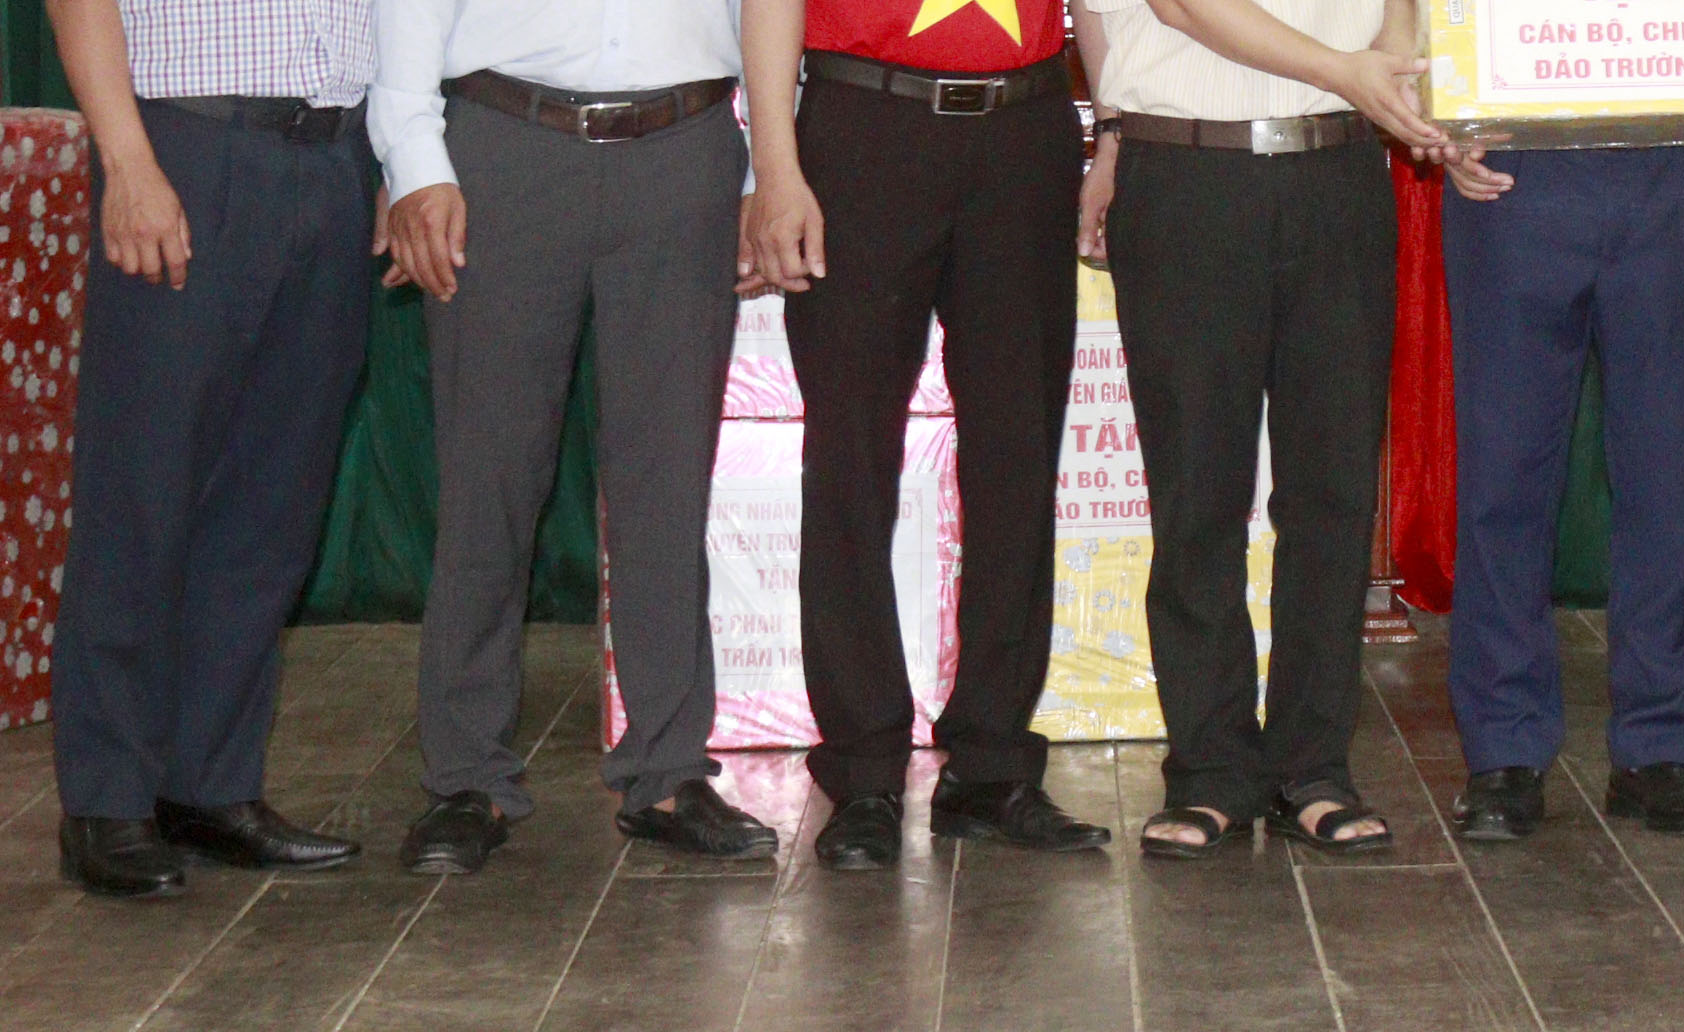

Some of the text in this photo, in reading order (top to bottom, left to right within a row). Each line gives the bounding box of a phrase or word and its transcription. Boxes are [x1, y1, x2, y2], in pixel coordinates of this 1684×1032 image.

[1519, 16, 1576, 44] CÁN
[1587, 16, 1632, 47] BỘ,
[1534, 51, 1591, 80] ĐẢO
[1075, 343, 1111, 370] OÀN
[1101, 377, 1130, 404] GIÁ
[1069, 417, 1138, 459] TẶ
[1077, 467, 1116, 492] BỘ,
[1055, 496, 1151, 520] ẢO TRƯỜ
[757, 563, 797, 594] TẶN
